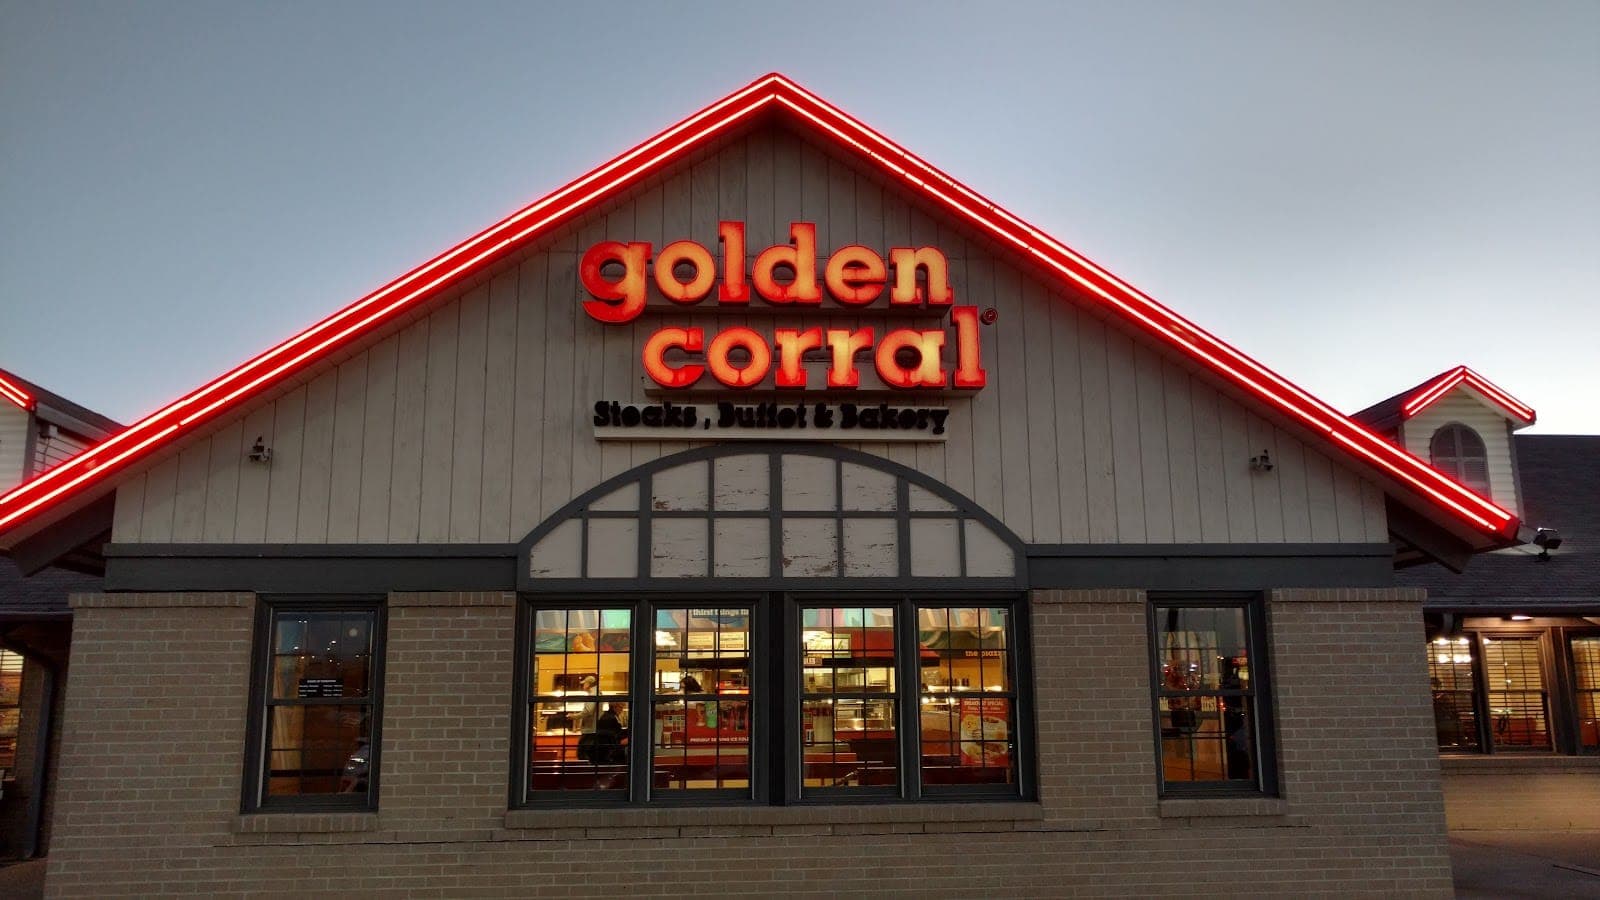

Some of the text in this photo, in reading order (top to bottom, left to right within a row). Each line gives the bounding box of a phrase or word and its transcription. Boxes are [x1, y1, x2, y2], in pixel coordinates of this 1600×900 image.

[579, 221, 955, 325] golden
[642, 305, 986, 389] corral
[717, 402, 807, 428] Buffet
[813, 402, 834, 428] &
[839, 403, 949, 435] Bakery
